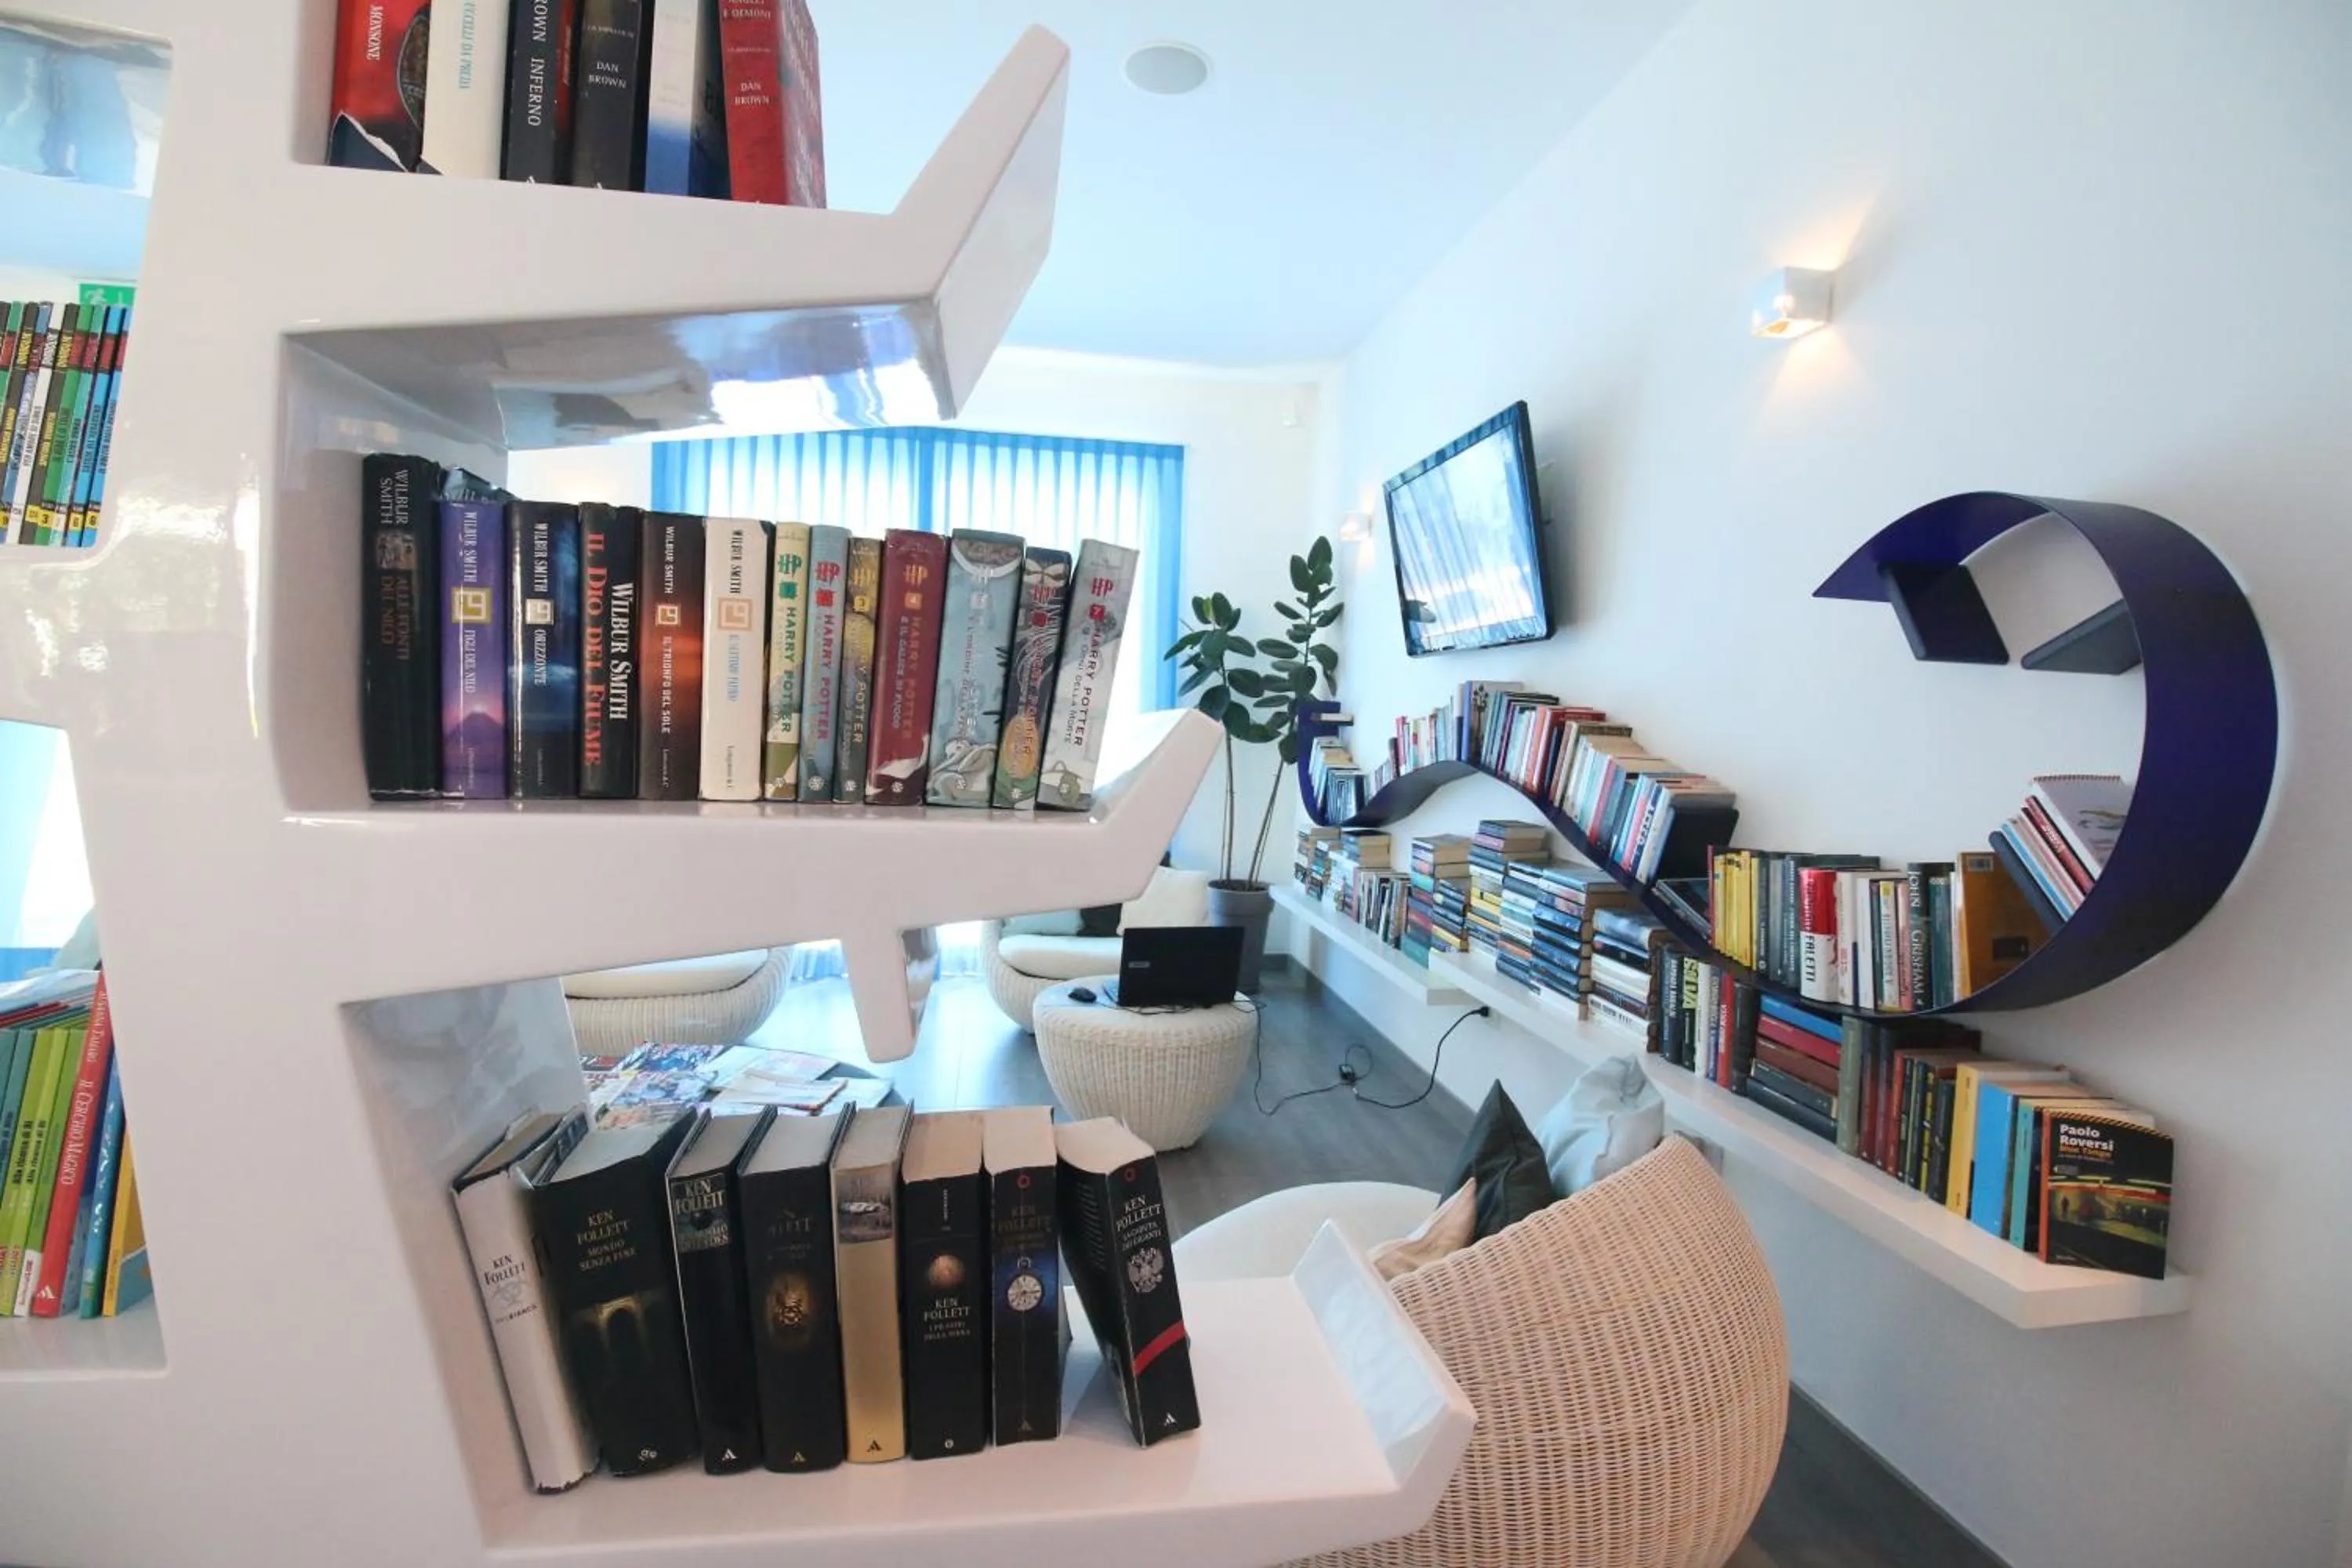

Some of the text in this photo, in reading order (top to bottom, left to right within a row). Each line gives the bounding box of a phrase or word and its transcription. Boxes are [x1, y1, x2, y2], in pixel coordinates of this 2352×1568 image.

[528, 0, 548, 126] ROWN INFERNO
[596, 61, 619, 73] DAN
[588, 74, 627, 89] BROWN
[740, 82, 762, 92] DAN
[734, 95, 770, 106] BROWN
[380, 478, 393, 524] SMITH
[394, 470, 408, 524] WILBUR
[463, 512, 477, 583] WILBUR SMITH
[664, 525, 676, 594] WILBUR SMITH
[534, 559, 548, 592] SMITH
[730, 564, 742, 594] SMITH
[534, 629, 546, 685] ORIZZONTE
[584, 534, 608, 765] IL DIO DEL FIUME
[610, 583, 633, 720] WILBUR SMITH
[662, 648, 673, 688] TRIONFO
[781, 607, 797, 733] HARRY POTTER
[817, 614, 836, 740] HARRY POTTER
[902, 616, 923, 741] HARRY POTTER
[662, 689, 672, 707] DEL
[1073, 628, 1102, 746] HARRY POTTER
[661, 710, 671, 734] SOLE
[852, 679, 867, 744] POTTER
[1909, 871, 1926, 994] JOHN GRISHAM
[1805, 935, 1816, 982] FALETTI
[69, 1094, 95, 1143] CERCHIO
[2060, 1123, 2100, 1137] Paolo
[2060, 1134, 2114, 1151] Roversi
[60, 1145, 85, 1185] MAGICO
[673, 1189, 725, 1216] FOLLETT
[684, 1178, 712, 1196] KEN
[587, 1210, 614, 1227] KEN
[1116, 1203, 1162, 1231] FOLLETT
[1123, 1194, 1147, 1213] KEN
[577, 1218, 630, 1245] FOLLETT
[484, 1261, 527, 1286] FOLLETT
[492, 1254, 513, 1269] KEN
[924, 1306, 971, 1322] FOLLETT
[935, 1297, 959, 1308] KEN
